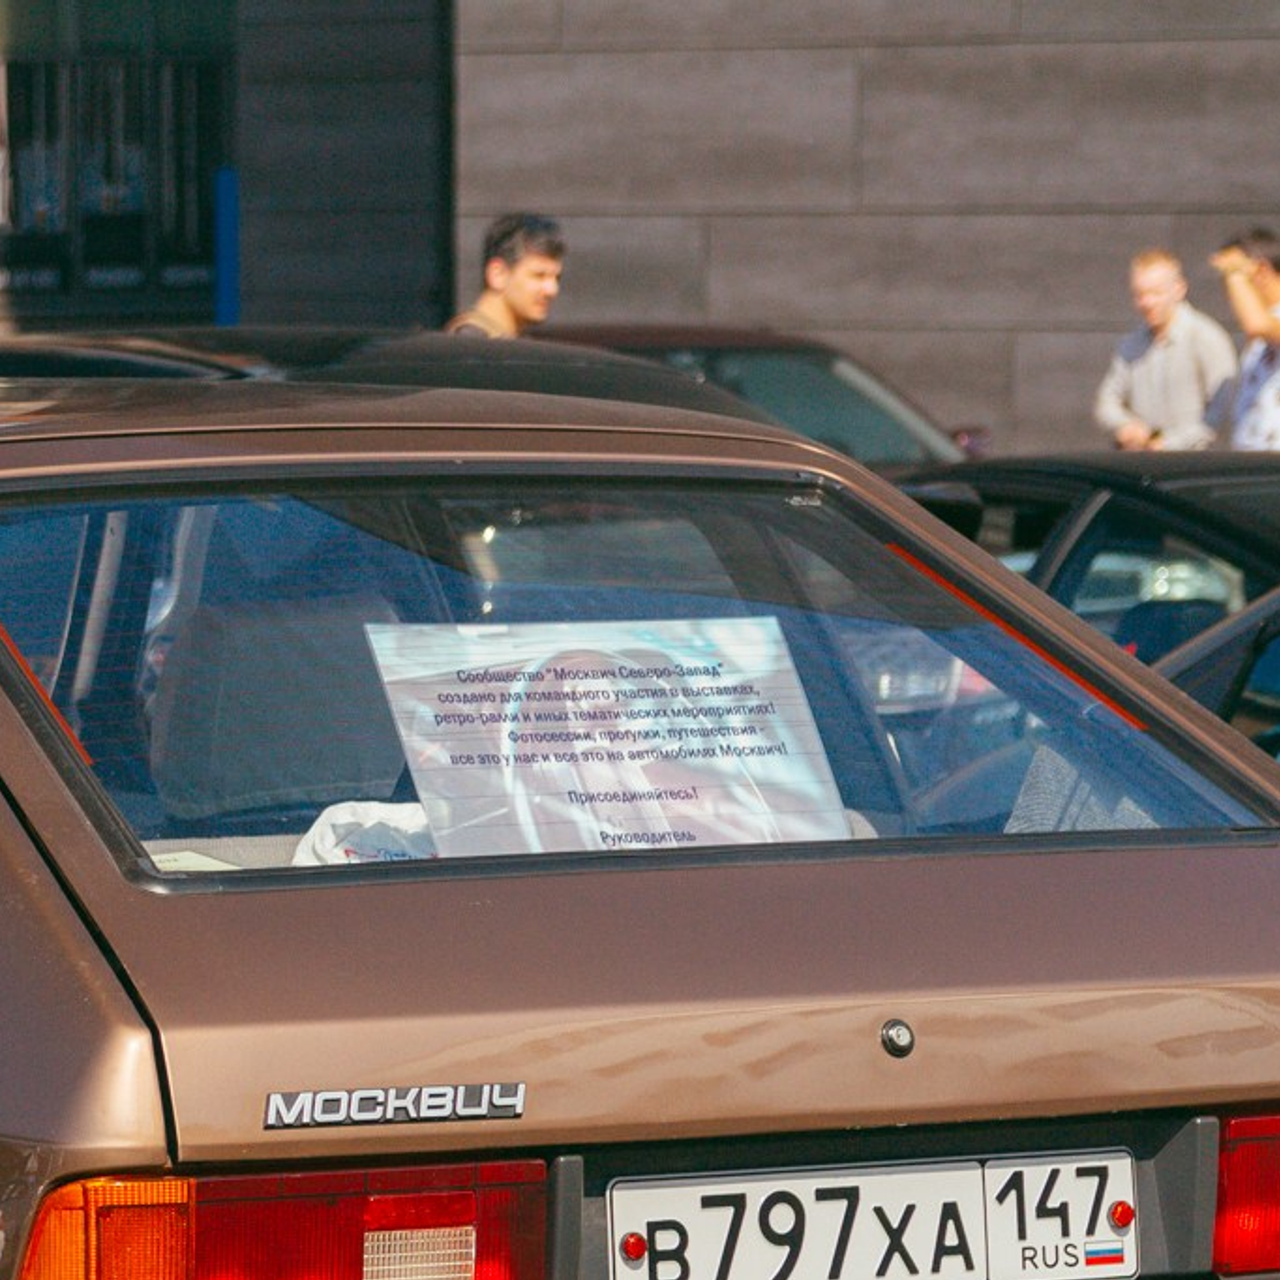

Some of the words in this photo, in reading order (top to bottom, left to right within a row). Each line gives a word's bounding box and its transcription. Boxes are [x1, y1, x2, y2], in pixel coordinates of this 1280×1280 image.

[456, 669, 545, 684] Сообщество
[437, 691, 497, 704] создано
[500, 691, 523, 704] для
[524, 689, 611, 703] командного
[613, 687, 667, 703] участия
[681, 683, 761, 698] выставках,
[522, 711, 532, 722] и
[534, 711, 569, 722] иных
[572, 707, 670, 722] тематических
[671, 701, 777, 719] мероприятиях!
[507, 730, 597, 745] Фотосессии,
[599, 728, 667, 744] прогулки,
[667, 723, 757, 741] путешествия
[449, 754, 476, 766] все
[477, 753, 501, 766] это
[502, 755, 511, 767] у
[513, 752, 540, 765] нас
[541, 754, 551, 764] и
[553, 752, 579, 764] все
[581, 751, 605, 763] это
[607, 750, 625, 763] на
[627, 745, 717, 762] автомобилях
[718, 741, 789, 757] Москвич!
[567, 785, 700, 807] Присоединяйтесь!
[599, 829, 697, 847] Руководитель
[994, 1165, 1110, 1242] 147
[1021, 1242, 1080, 1271] RUS
